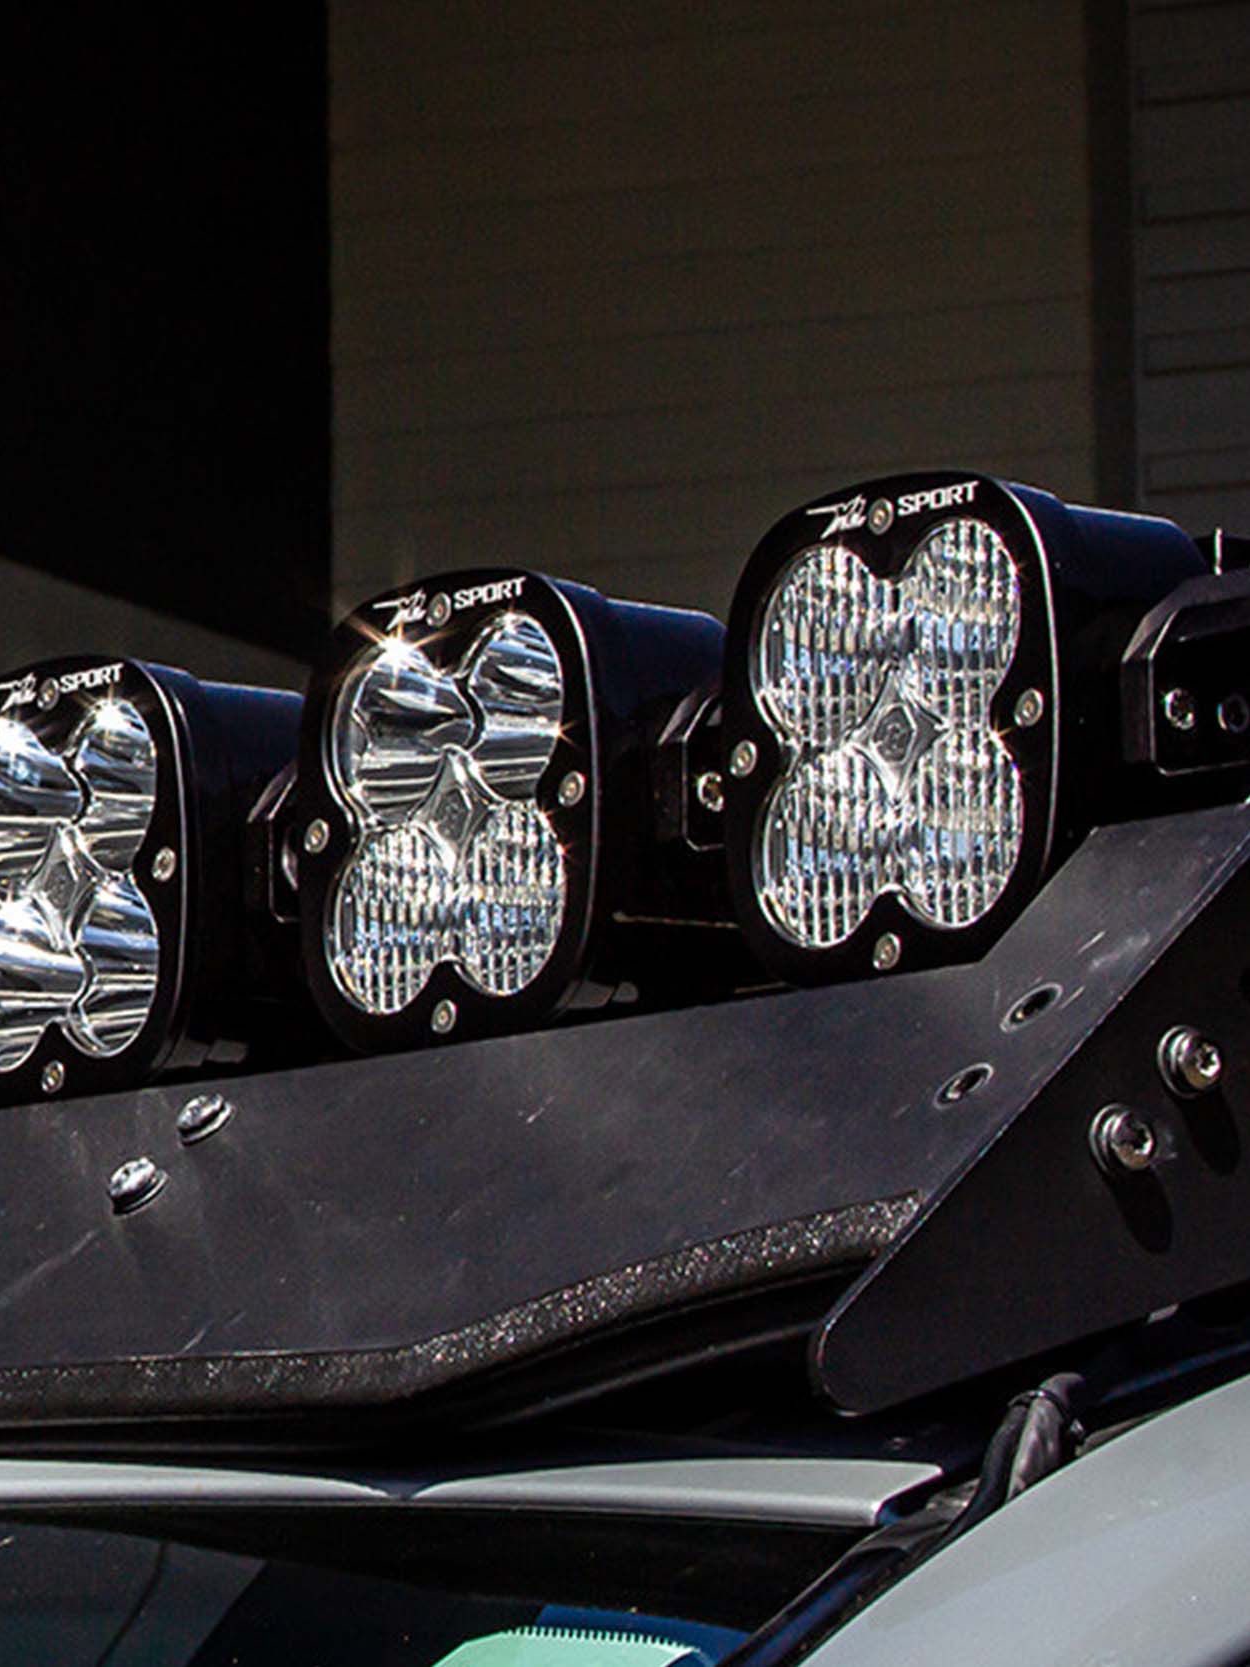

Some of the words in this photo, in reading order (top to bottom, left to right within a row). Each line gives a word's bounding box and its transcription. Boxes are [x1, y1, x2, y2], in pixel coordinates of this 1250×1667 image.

[898, 481, 979, 516] SPORT
[453, 576, 527, 610] SPORT
[60, 663, 124, 693] SPORT
